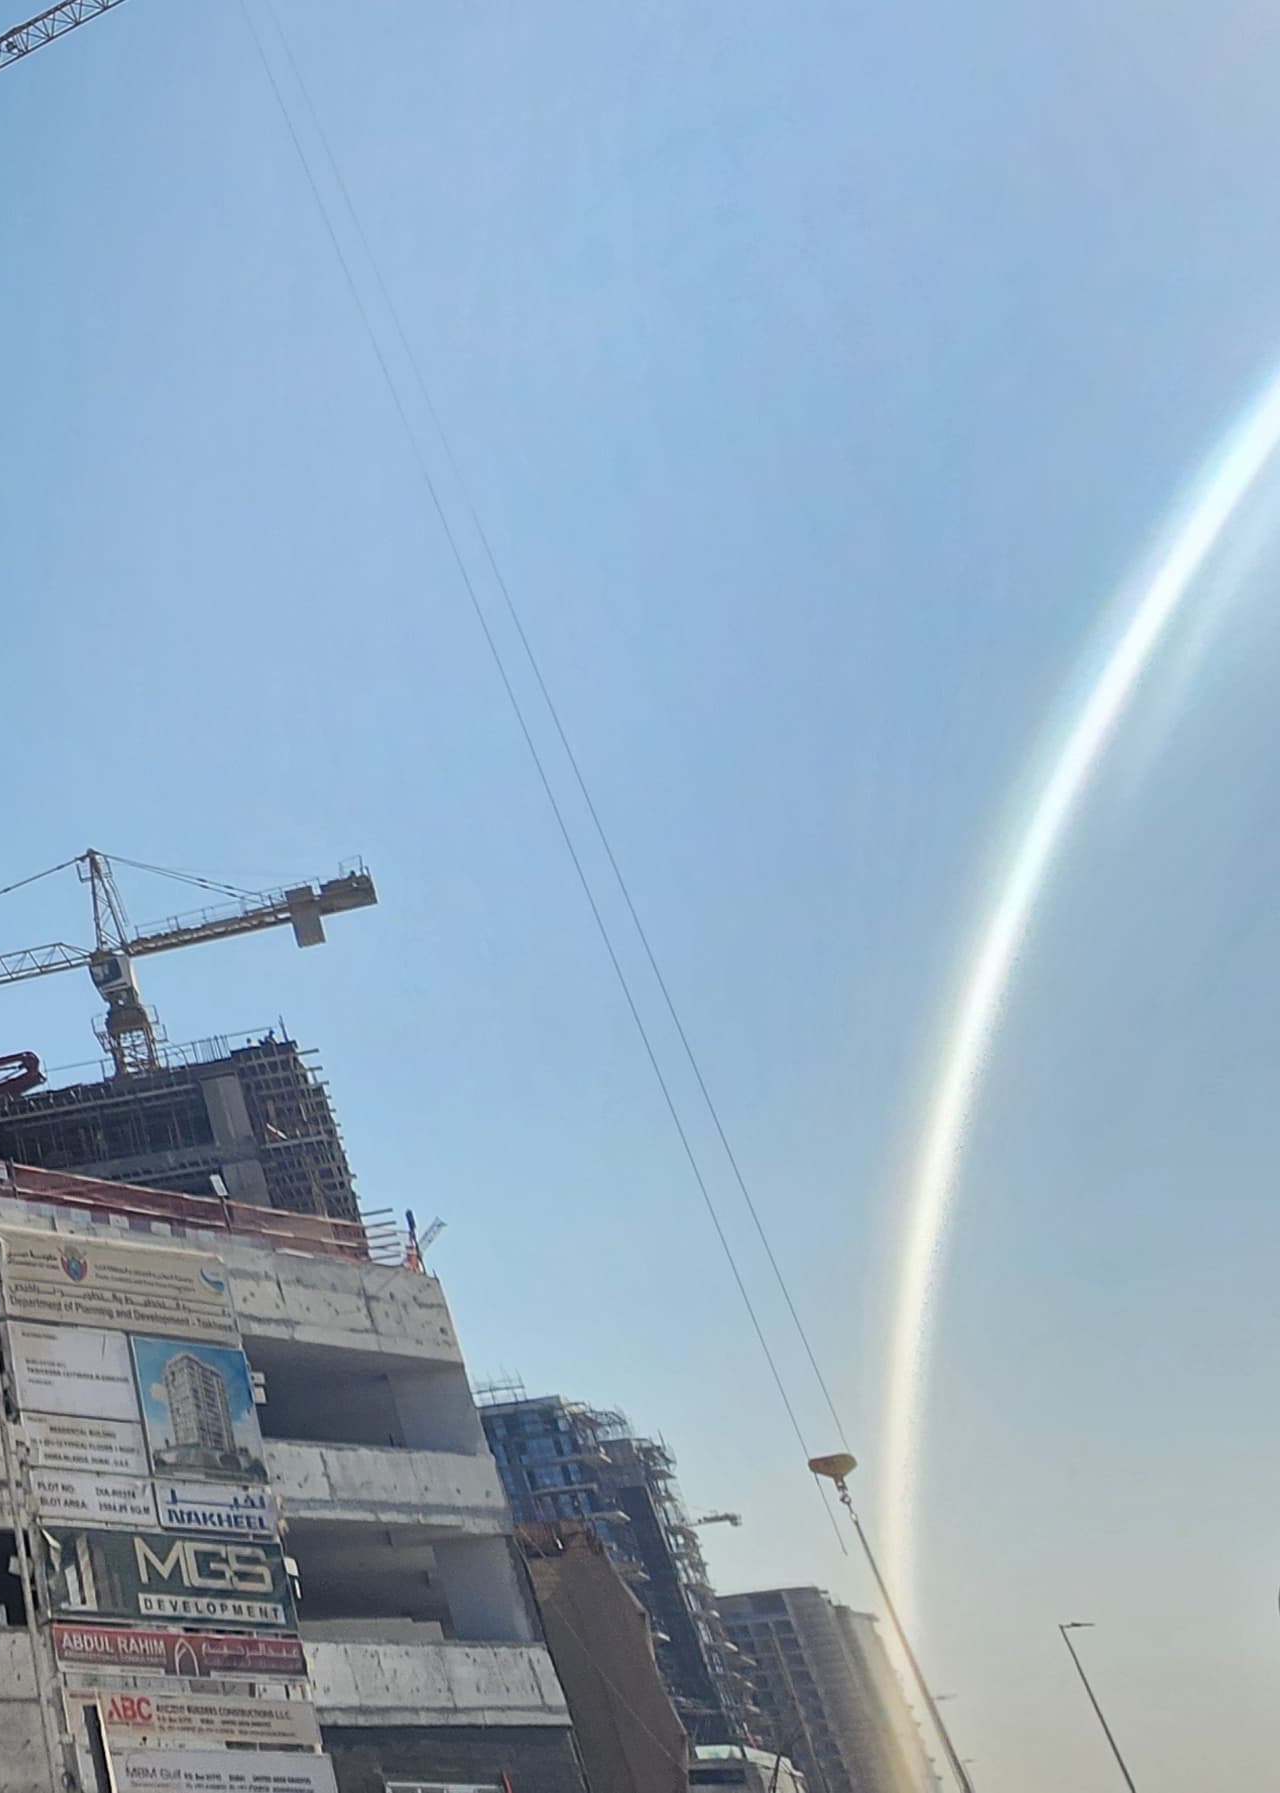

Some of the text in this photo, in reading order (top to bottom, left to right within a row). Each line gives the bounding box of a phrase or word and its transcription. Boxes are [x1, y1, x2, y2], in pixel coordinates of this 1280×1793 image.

[10, 1295, 61, 1312] Department
[167, 1509, 269, 1530] NAKHEEL
[134, 1537, 274, 1592] MGS
[144, 1597, 280, 1620] DEVELOPMENT
[62, 1631, 167, 1657] ABDUL RAHIM
[107, 1695, 153, 1721] ABC
